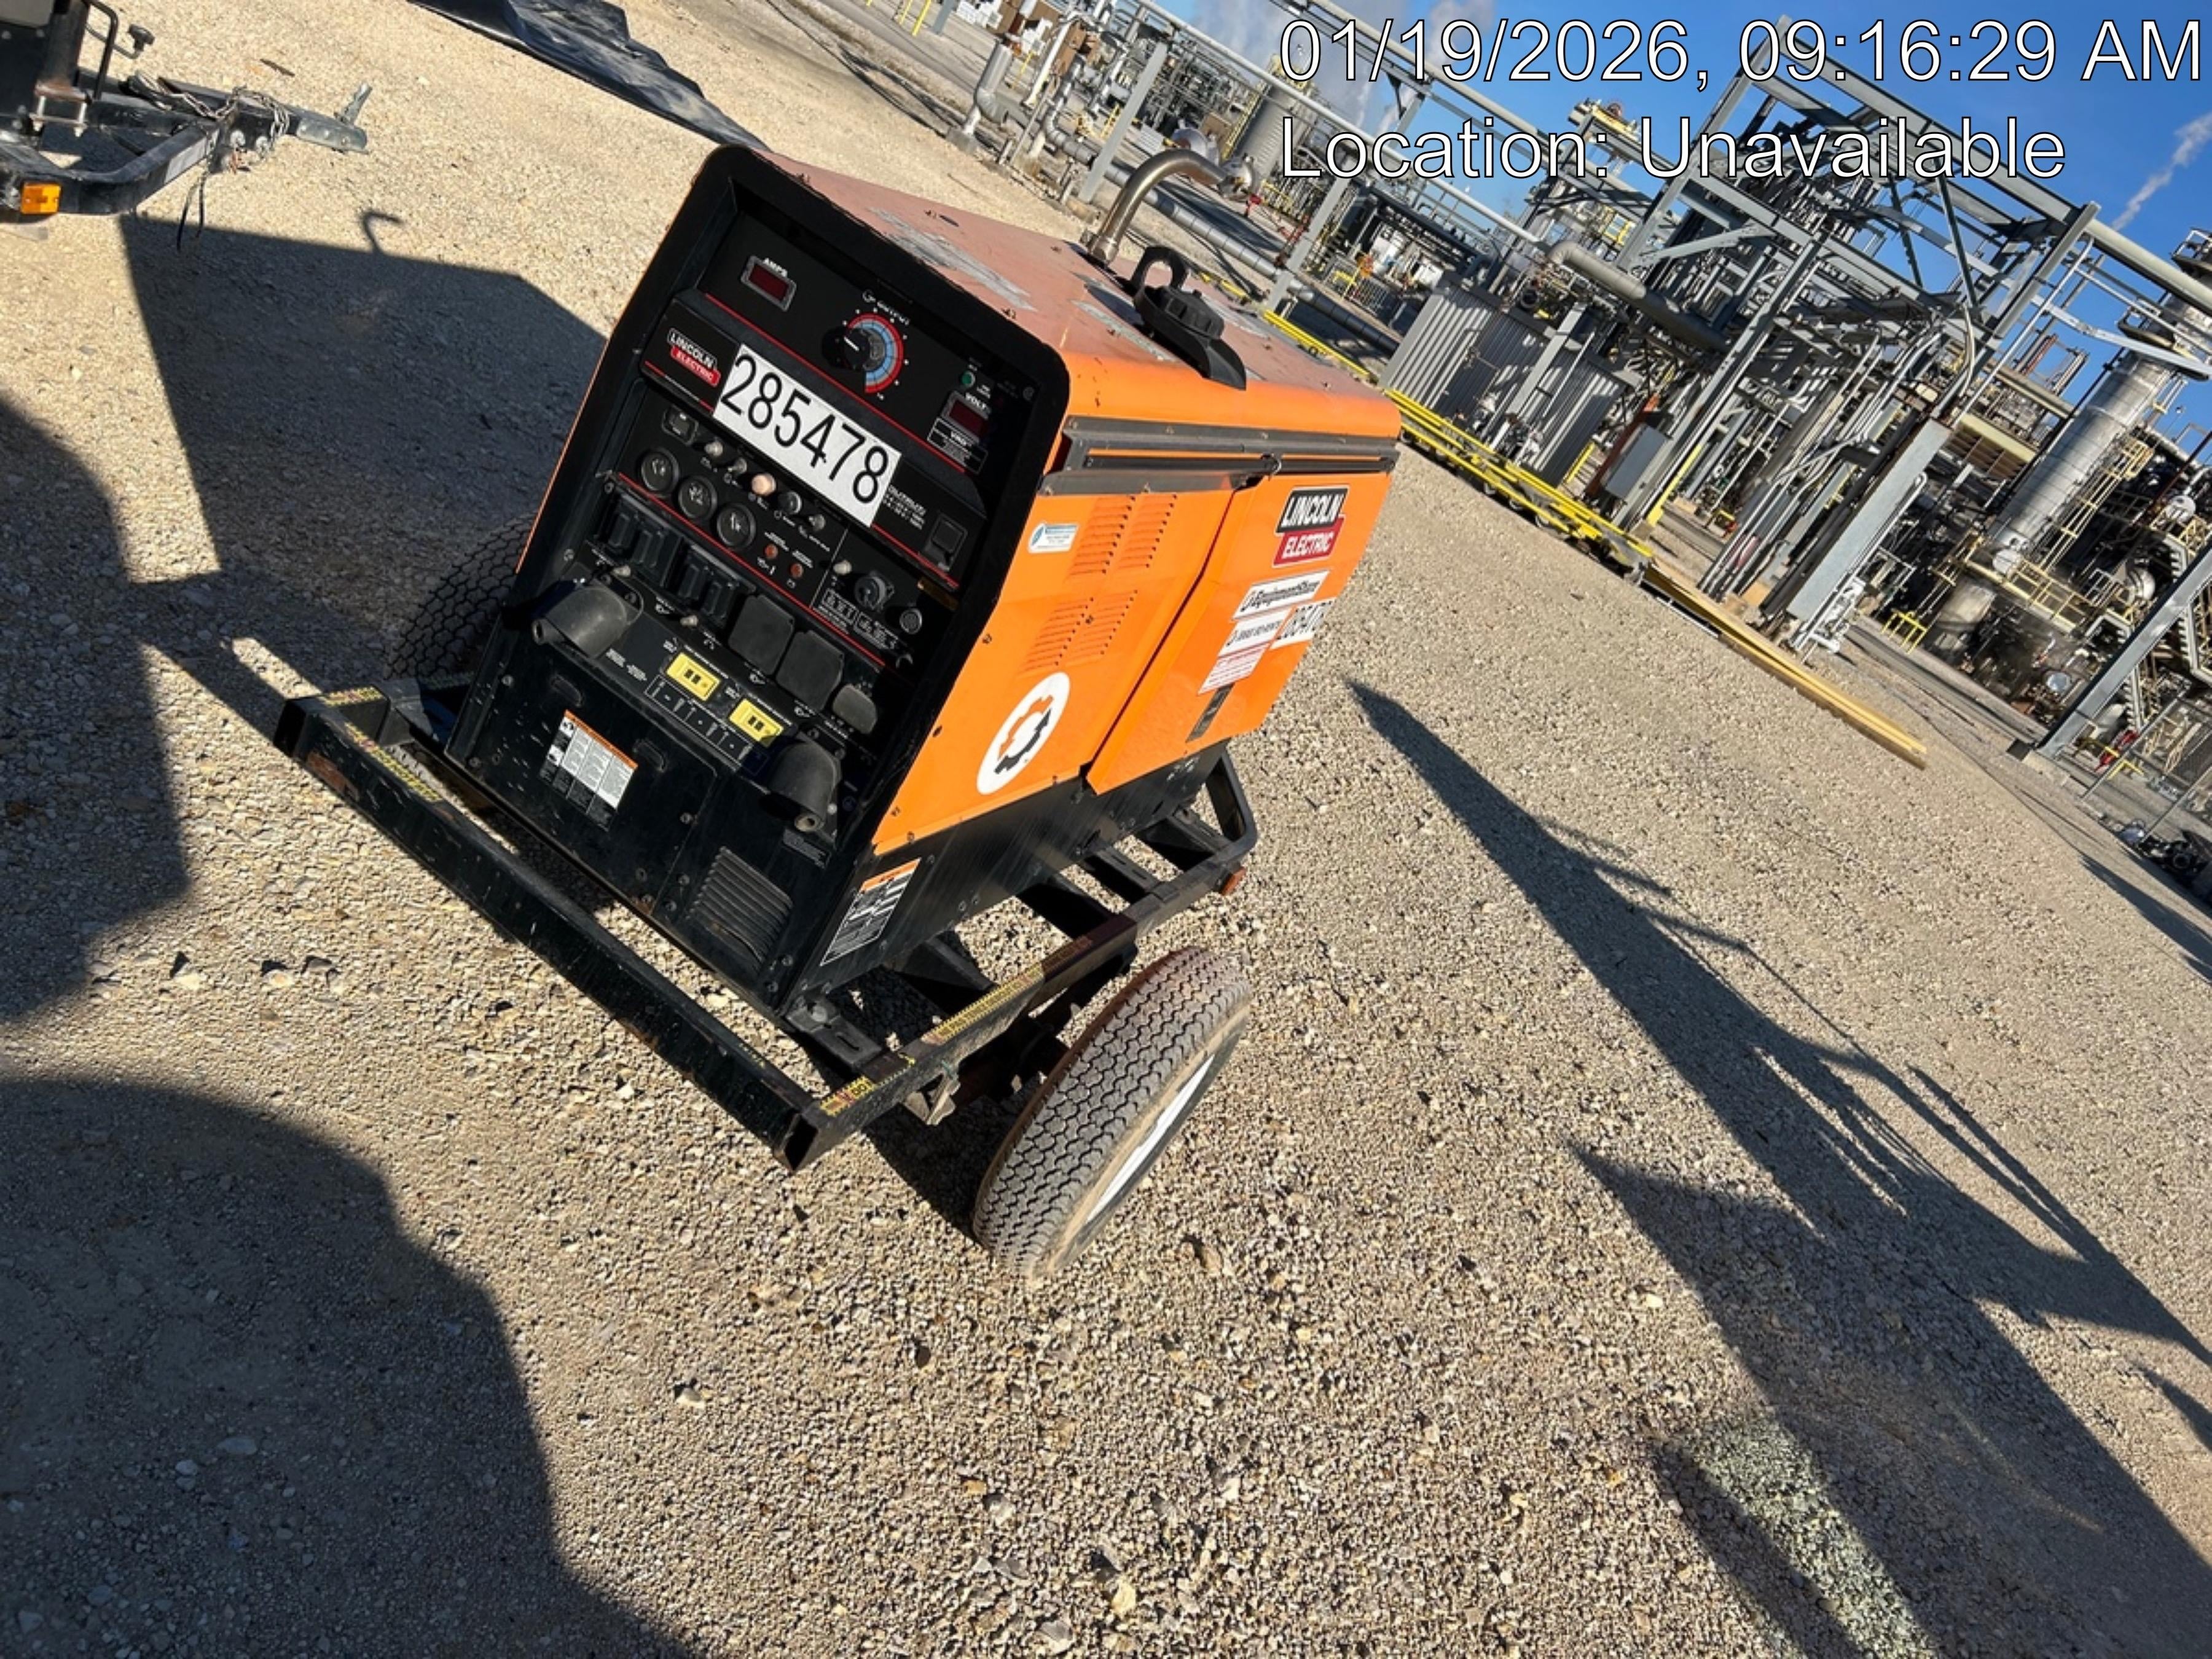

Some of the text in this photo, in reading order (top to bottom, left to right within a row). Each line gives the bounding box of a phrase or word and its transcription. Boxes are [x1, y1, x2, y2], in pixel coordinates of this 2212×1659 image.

[670, 332, 715, 369] LINCOLN
[677, 350, 713, 382] ELECTRIC
[720, 354, 888, 504] 285478
[1280, 493, 1344, 529] LINCOLN
[1281, 531, 1335, 559] ELECTRIC
